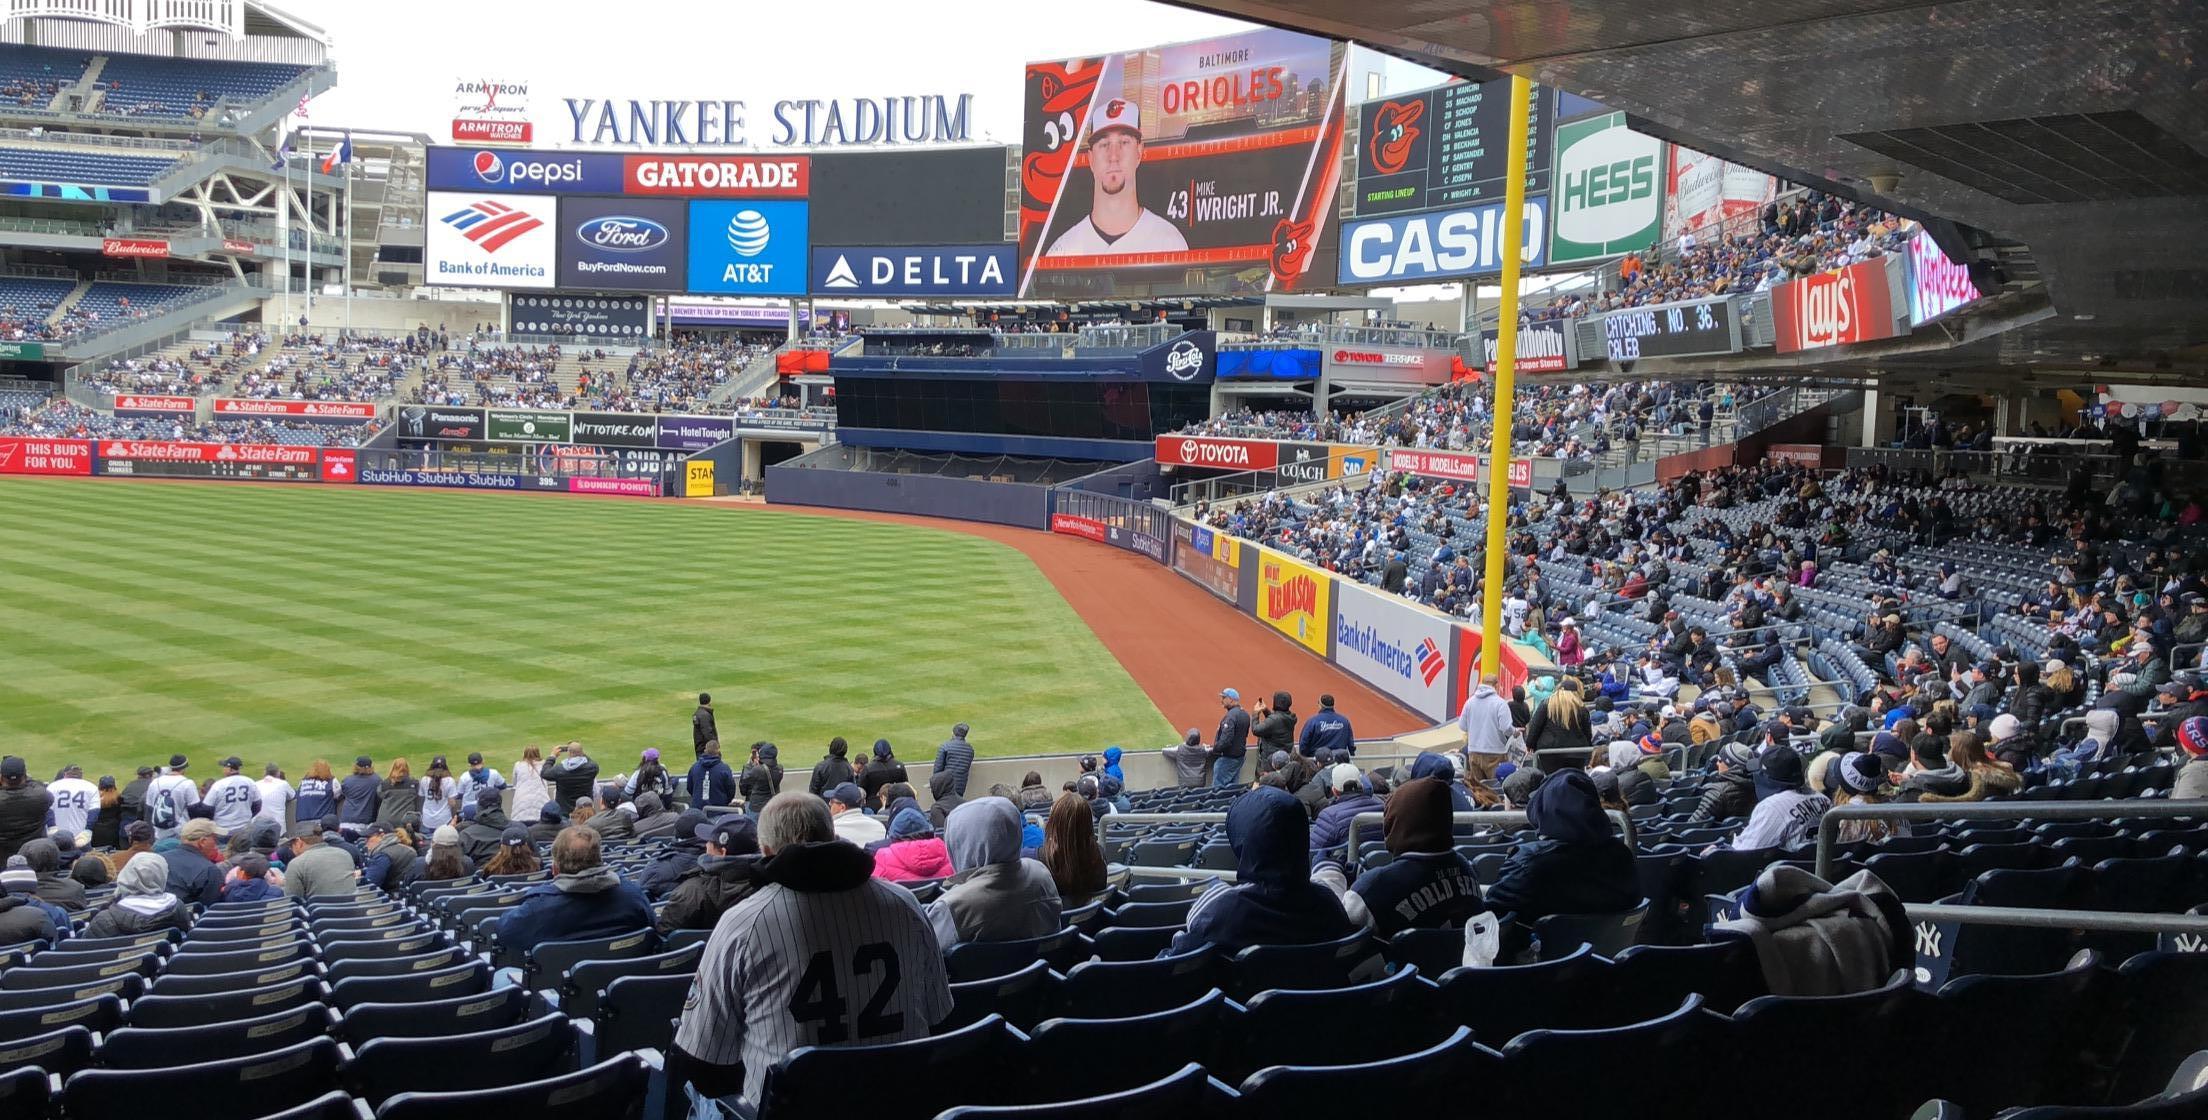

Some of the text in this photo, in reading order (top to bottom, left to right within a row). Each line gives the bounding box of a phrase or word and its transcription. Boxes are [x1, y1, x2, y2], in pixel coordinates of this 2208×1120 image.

[1200, 49, 1248, 68] BALTIMORE
[456, 83, 527, 95] ARMITRON
[1163, 66, 1283, 114] ORIOLES
[1456, 93, 1482, 106] MACHADO
[563, 93, 975, 145] YANKEE STADIUM
[1455, 106, 1477, 118] SCHOOP
[459, 122, 524, 133] ARMITRON
[1454, 117, 1472, 129] JONES
[1442, 127, 1479, 142] DH VALENCIA
[1167, 140, 1227, 157] BALTIMORE
[1237, 133, 1284, 151] ORIOLES
[1453, 138, 1480, 151] BECKHAM
[1452, 148, 1485, 162] SANTANDER
[510, 159, 583, 185] pepsi
[637, 162, 798, 188] GATORADE
[1442, 161, 1474, 174] LF GENTRY
[1444, 173, 1472, 185] C JOSEPH
[1564, 155, 1653, 212] HESS
[1196, 181, 1215, 196] MIKE
[1367, 187, 1416, 202] STARTING LINEUP
[1451, 188, 1472, 199] WRIGHT
[1167, 190, 1284, 222] 43 WRIGHT JR.
[595, 219, 651, 247] Ford
[1350, 202, 1543, 278] CASIO
[104, 241, 167, 254] Budweiser
[439, 260, 545, 277] Bank of America
[578, 261, 667, 275] BuyFordNow.com
[722, 263, 773, 284] AT&T
[872, 255, 1004, 285] DELTA
[566, 311, 581, 322] York
[580, 311, 609, 322] Yankees
[713, 308, 721, 317] UP
[729, 309, 739, 317] NEW
[1802, 271, 1850, 349] Lay's
[1667, 308, 1689, 333] NO.
[1607, 337, 1640, 361] CALEB
[1350, 352, 1424, 365] TOYOTA TERRACE
[1520, 360, 1539, 369] Super
[1540, 359, 1563, 368] Stores
[431, 412, 480, 423] Panasonic
[574, 420, 656, 439] NITTOTIRE.COM
[25, 443, 88, 457] THIS BUD'S
[1200, 444, 1249, 465] TOYOTA
[25, 456, 48, 468] FOR
[50, 457, 77, 469] YOU.
[626, 451, 661, 472] SUB
[1344, 461, 1361, 476] SAP
[1394, 453, 1419, 470] MODELL'S
[1429, 456, 1474, 476] MODELLS.com
[362, 470, 515, 487] StubHub StubHub StubHub
[1281, 464, 1324, 481] COACH
[583, 480, 651, 492] DUNKIN' DONUT
[1282, 573, 1318, 619] MASON
[1513, 608, 1527, 621] 52
[1338, 612, 1360, 653] Bank
[1360, 625, 1371, 657] of
[1370, 628, 1412, 679] America
[57, 790, 85, 810] 24
[225, 785, 249, 804] 23
[1395, 878, 1454, 922] WORLD
[1915, 920, 1942, 958] NY
[788, 940, 905, 1044] 42
